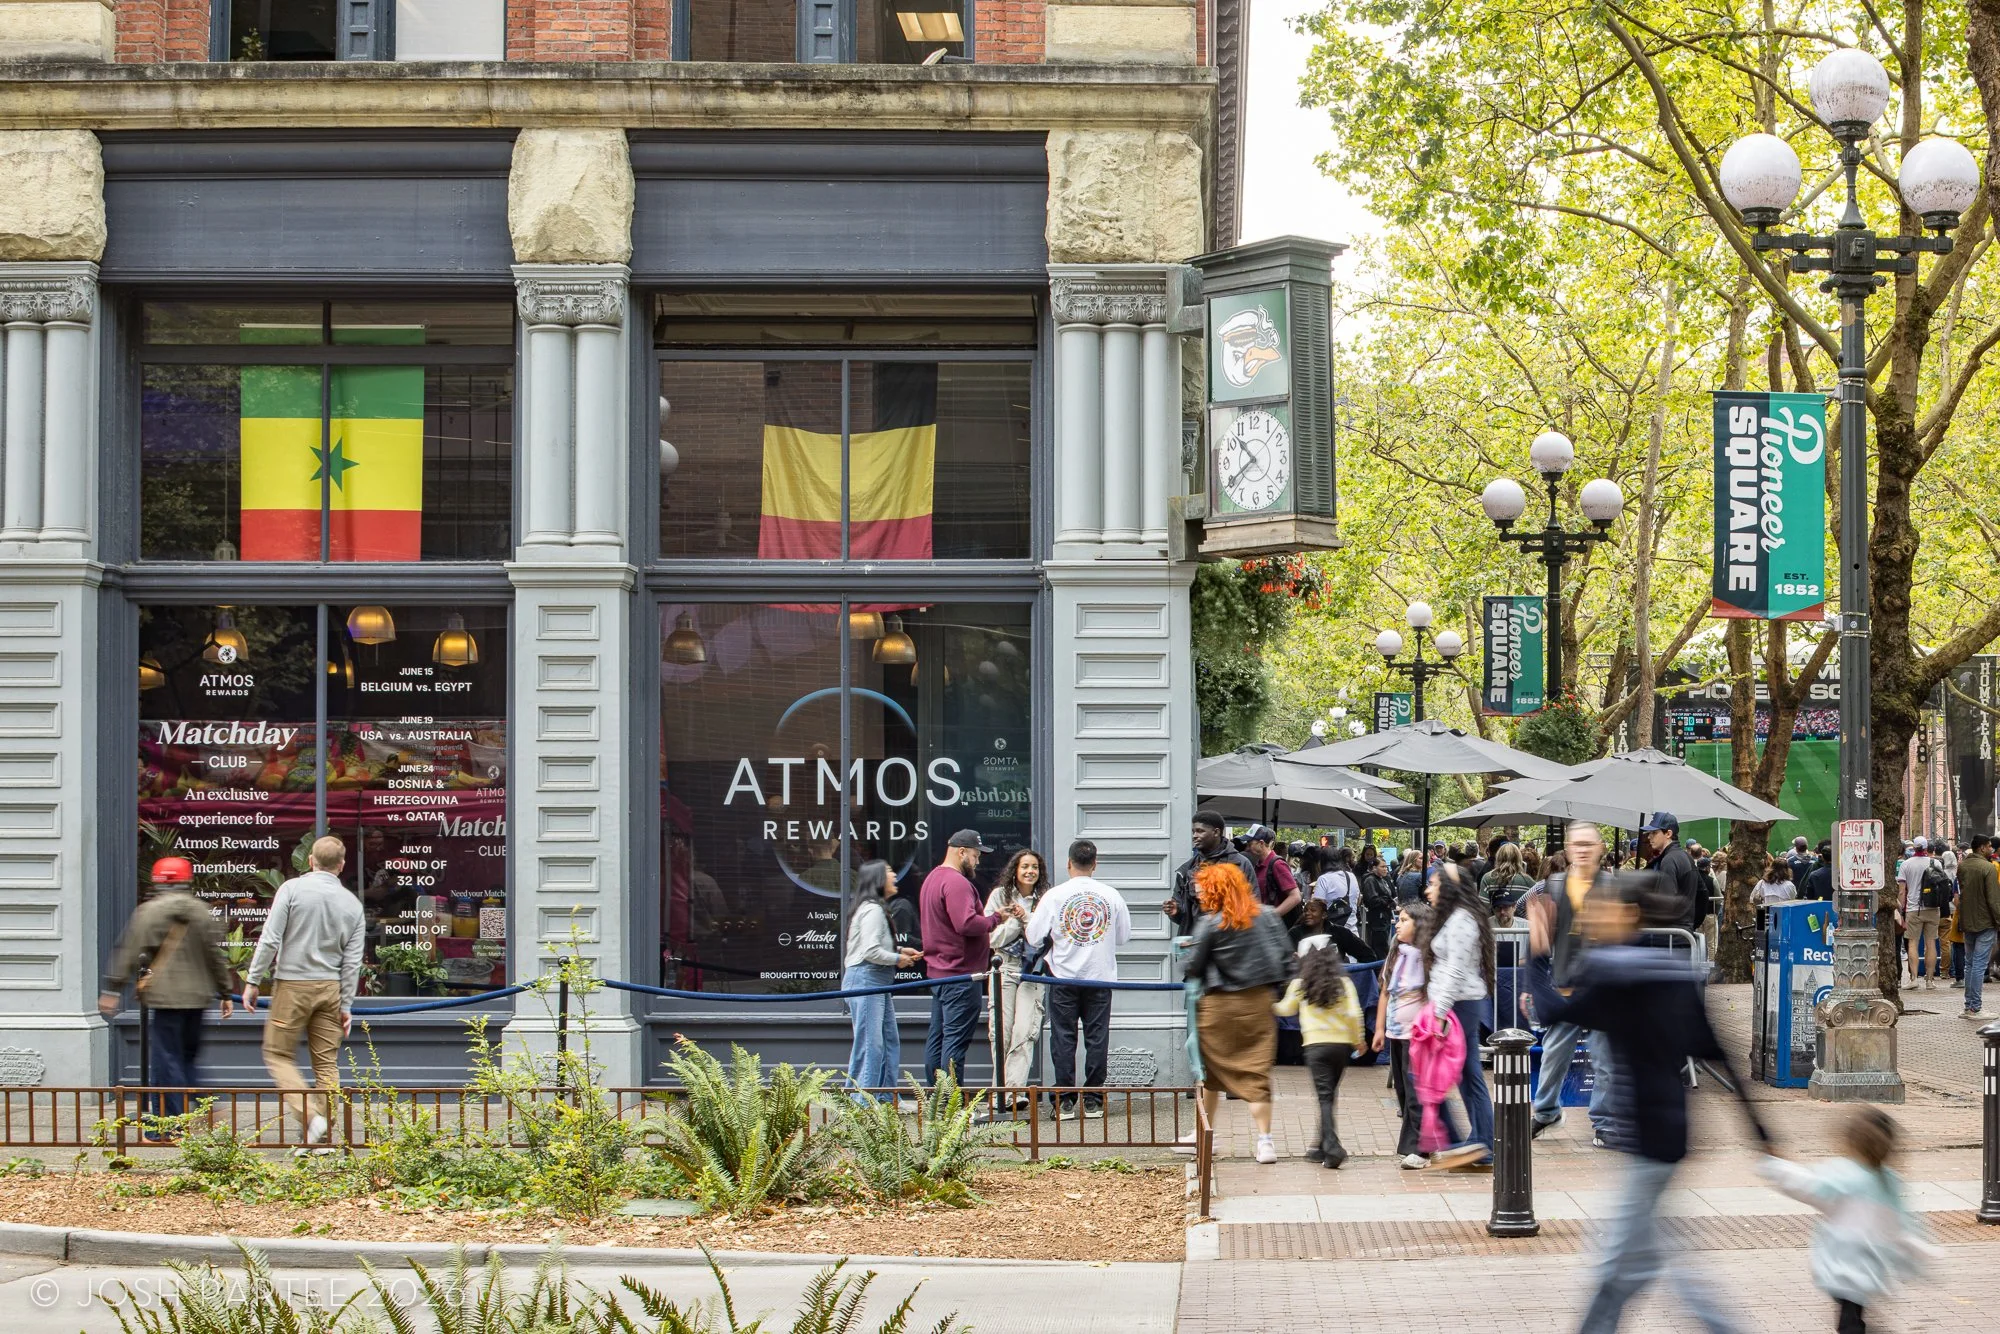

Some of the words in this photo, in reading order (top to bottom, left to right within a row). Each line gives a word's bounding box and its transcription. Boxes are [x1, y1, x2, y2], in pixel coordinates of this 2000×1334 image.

[1237, 421, 1244, 436] 11
[1249, 415, 1260, 430] 12
[1265, 418, 1271, 434] 1
[1226, 437, 1237, 451] 10
[1275, 432, 1283, 447] 2
[1222, 456, 1230, 470] 9
[1279, 449, 1287, 465] 3
[1275, 469, 1283, 483] 4
[1761, 407, 1824, 553] Pioneer
[1238, 487, 1244, 502] 7
[1252, 491, 1260, 506] 6
[1266, 485, 1274, 500] 5
[1725, 406, 1757, 592] SQUARE
[1775, 584, 1819, 595] 1852
[1509, 604, 1542, 681] Pioneer
[1490, 603, 1507, 703] SQUARE
[200, 675, 253, 687] ATMOS
[360, 682, 413, 692] BELGIUM
[416, 684, 431, 692] vs.
[434, 682, 472, 692] EGYPT
[1378, 697, 1389, 728] SQU
[1389, 697, 1410, 726] Pion
[156, 720, 298, 750] Matchday
[360, 731, 383, 740] USA
[408, 731, 473, 740] AUSTRALIA
[209, 755, 247, 768] CLUB
[388, 779, 433, 789] BOSNIA
[436, 779, 444, 789] &
[723, 757, 961, 807] ATMOS
[184, 788, 205, 800] An
[207, 788, 269, 800] exclusive
[476, 788, 506, 797] ATMO
[374, 795, 459, 805] HERZEGOVINA
[179, 812, 253, 828] experience
[255, 812, 274, 824] for
[405, 811, 445, 821] QATAR
[437, 815, 506, 837] Match
[763, 820, 929, 841] REWARDS
[174, 836, 219, 849] Atmos
[221, 836, 279, 849] Rewards
[193, 860, 259, 873] members.
[385, 860, 427, 870] ROUND
[431, 860, 447, 870] OF
[396, 875, 412, 886] 32
[417, 875, 435, 886] KO
[1852, 868, 1872, 879] TIME
[201, 890, 220, 899] loyalty
[246, 891, 254, 899] by
[450, 889, 468, 897] Need
[468, 891, 483, 899] your
[807, 911, 814, 919] A
[814, 911, 839, 920] loyalty
[385, 925, 427, 935] ROUND
[431, 925, 447, 935] OF
[796, 930, 837, 942] Alaska
[400, 941, 412, 951] 16
[415, 941, 432, 951] KO
[1803, 947, 1834, 964] Recy
